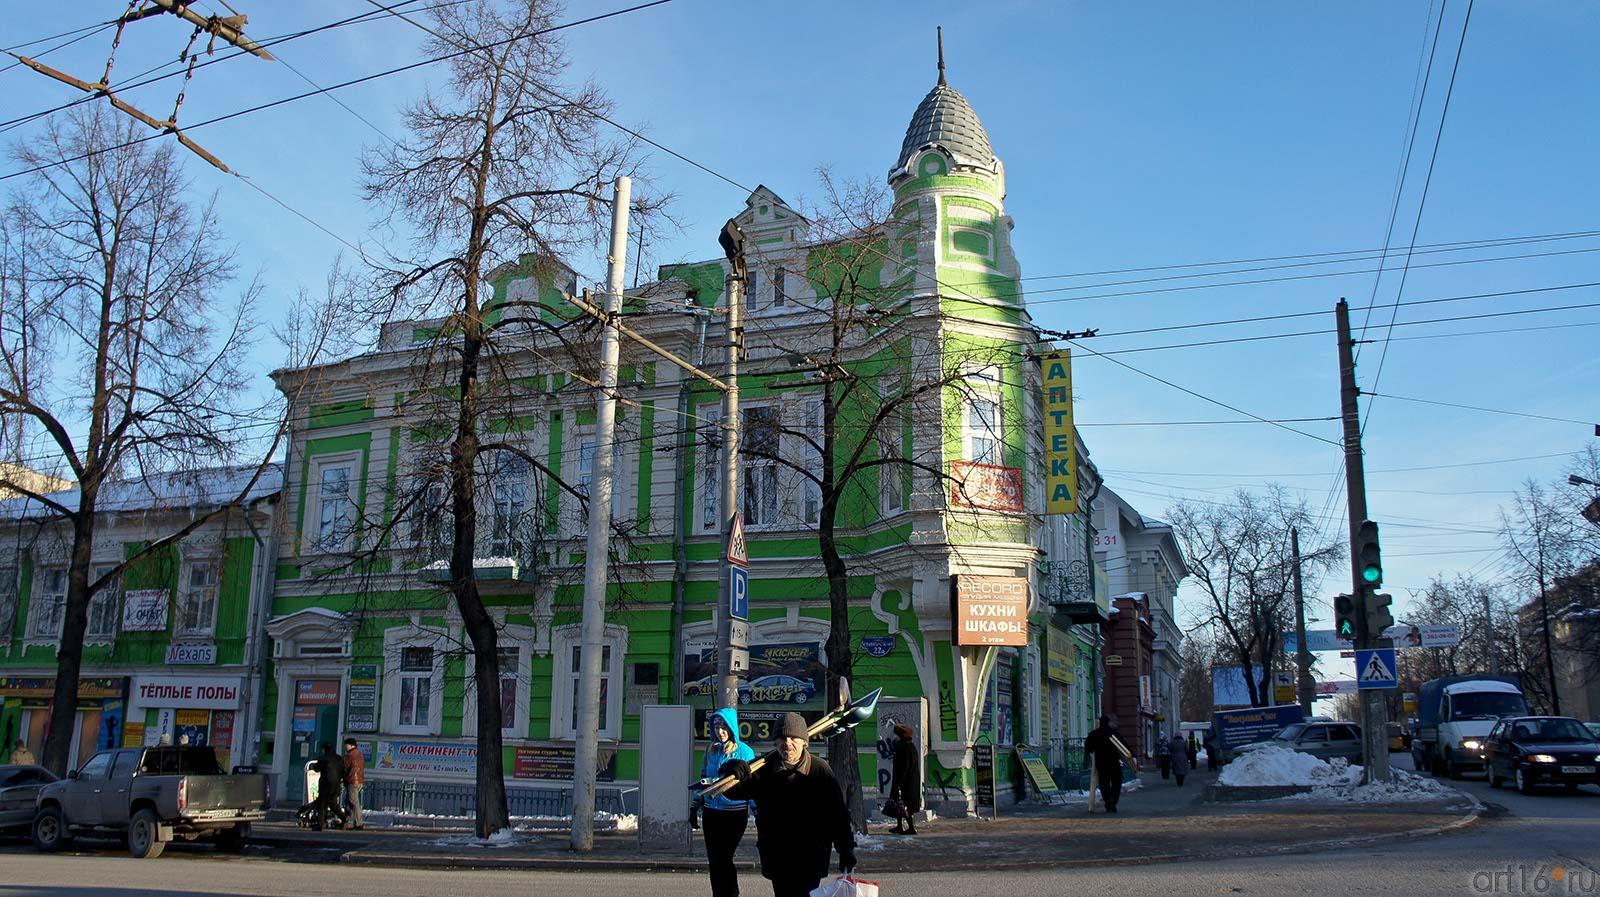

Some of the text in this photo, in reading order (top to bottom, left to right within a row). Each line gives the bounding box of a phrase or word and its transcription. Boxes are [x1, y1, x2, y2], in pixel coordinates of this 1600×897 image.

[1047, 362, 1072, 501] АПТЕКА
[960, 582, 1022, 594] RECORD
[970, 604, 1017, 617] КУХНИ
[965, 620, 1021, 633] ШКАФЫ
[169, 648, 212, 661] Nexans
[772, 648, 809, 657] KICKER
[140, 683, 237, 700] ТЁПЛЫЕ ПОЛЫ
[761, 684, 802, 699] KICKER
